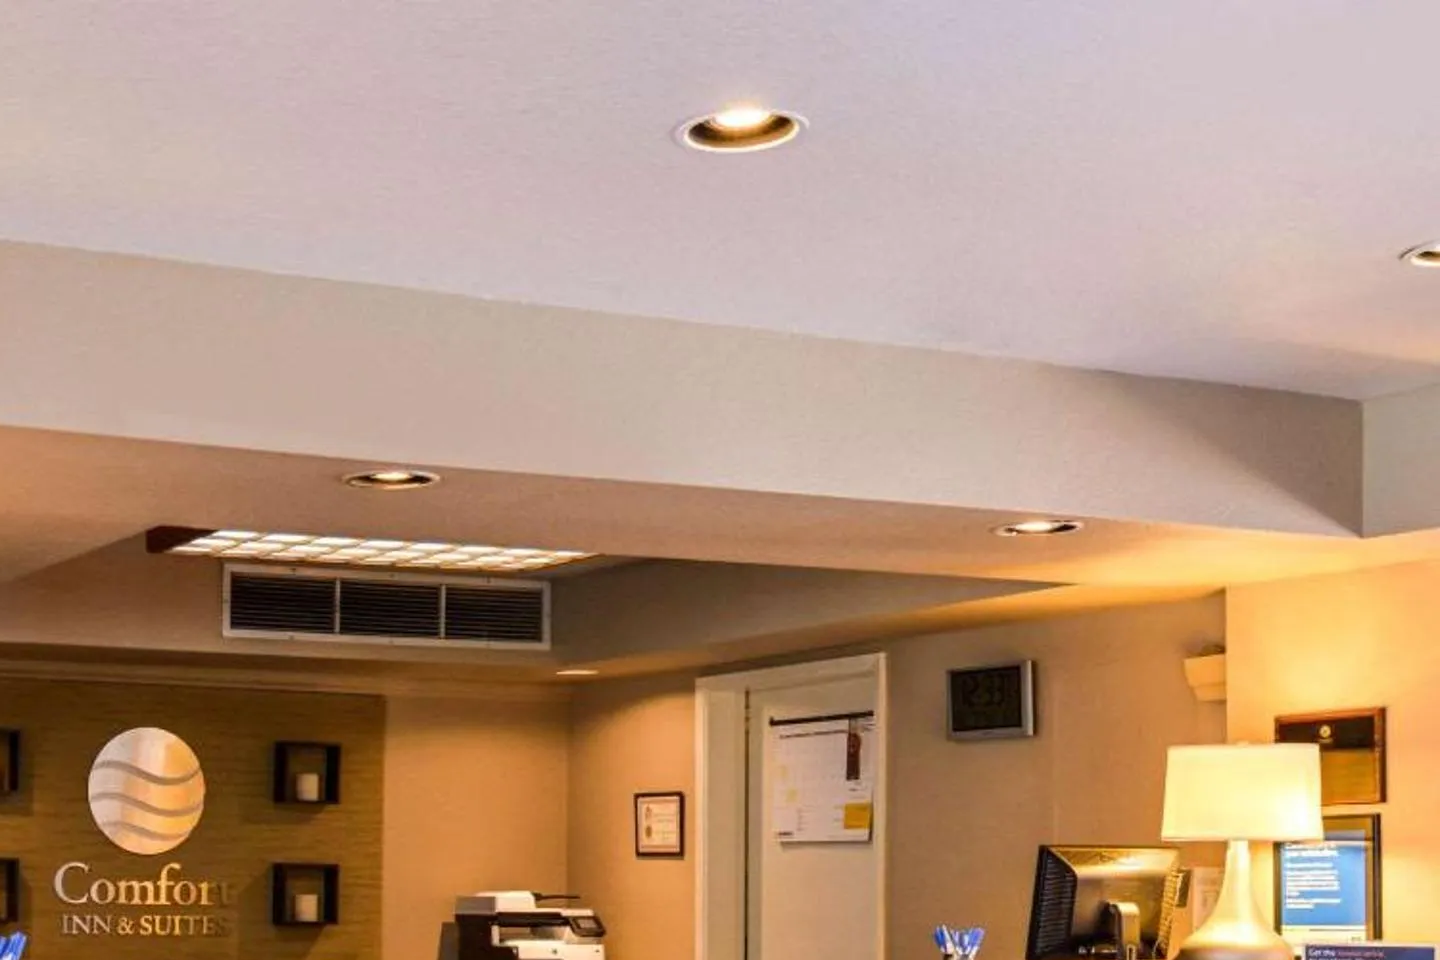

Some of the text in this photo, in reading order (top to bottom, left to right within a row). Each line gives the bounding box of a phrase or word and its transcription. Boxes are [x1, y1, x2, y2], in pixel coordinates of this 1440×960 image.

[54, 861, 231, 905] Comfort
[63, 915, 232, 936] INN & SUITES
